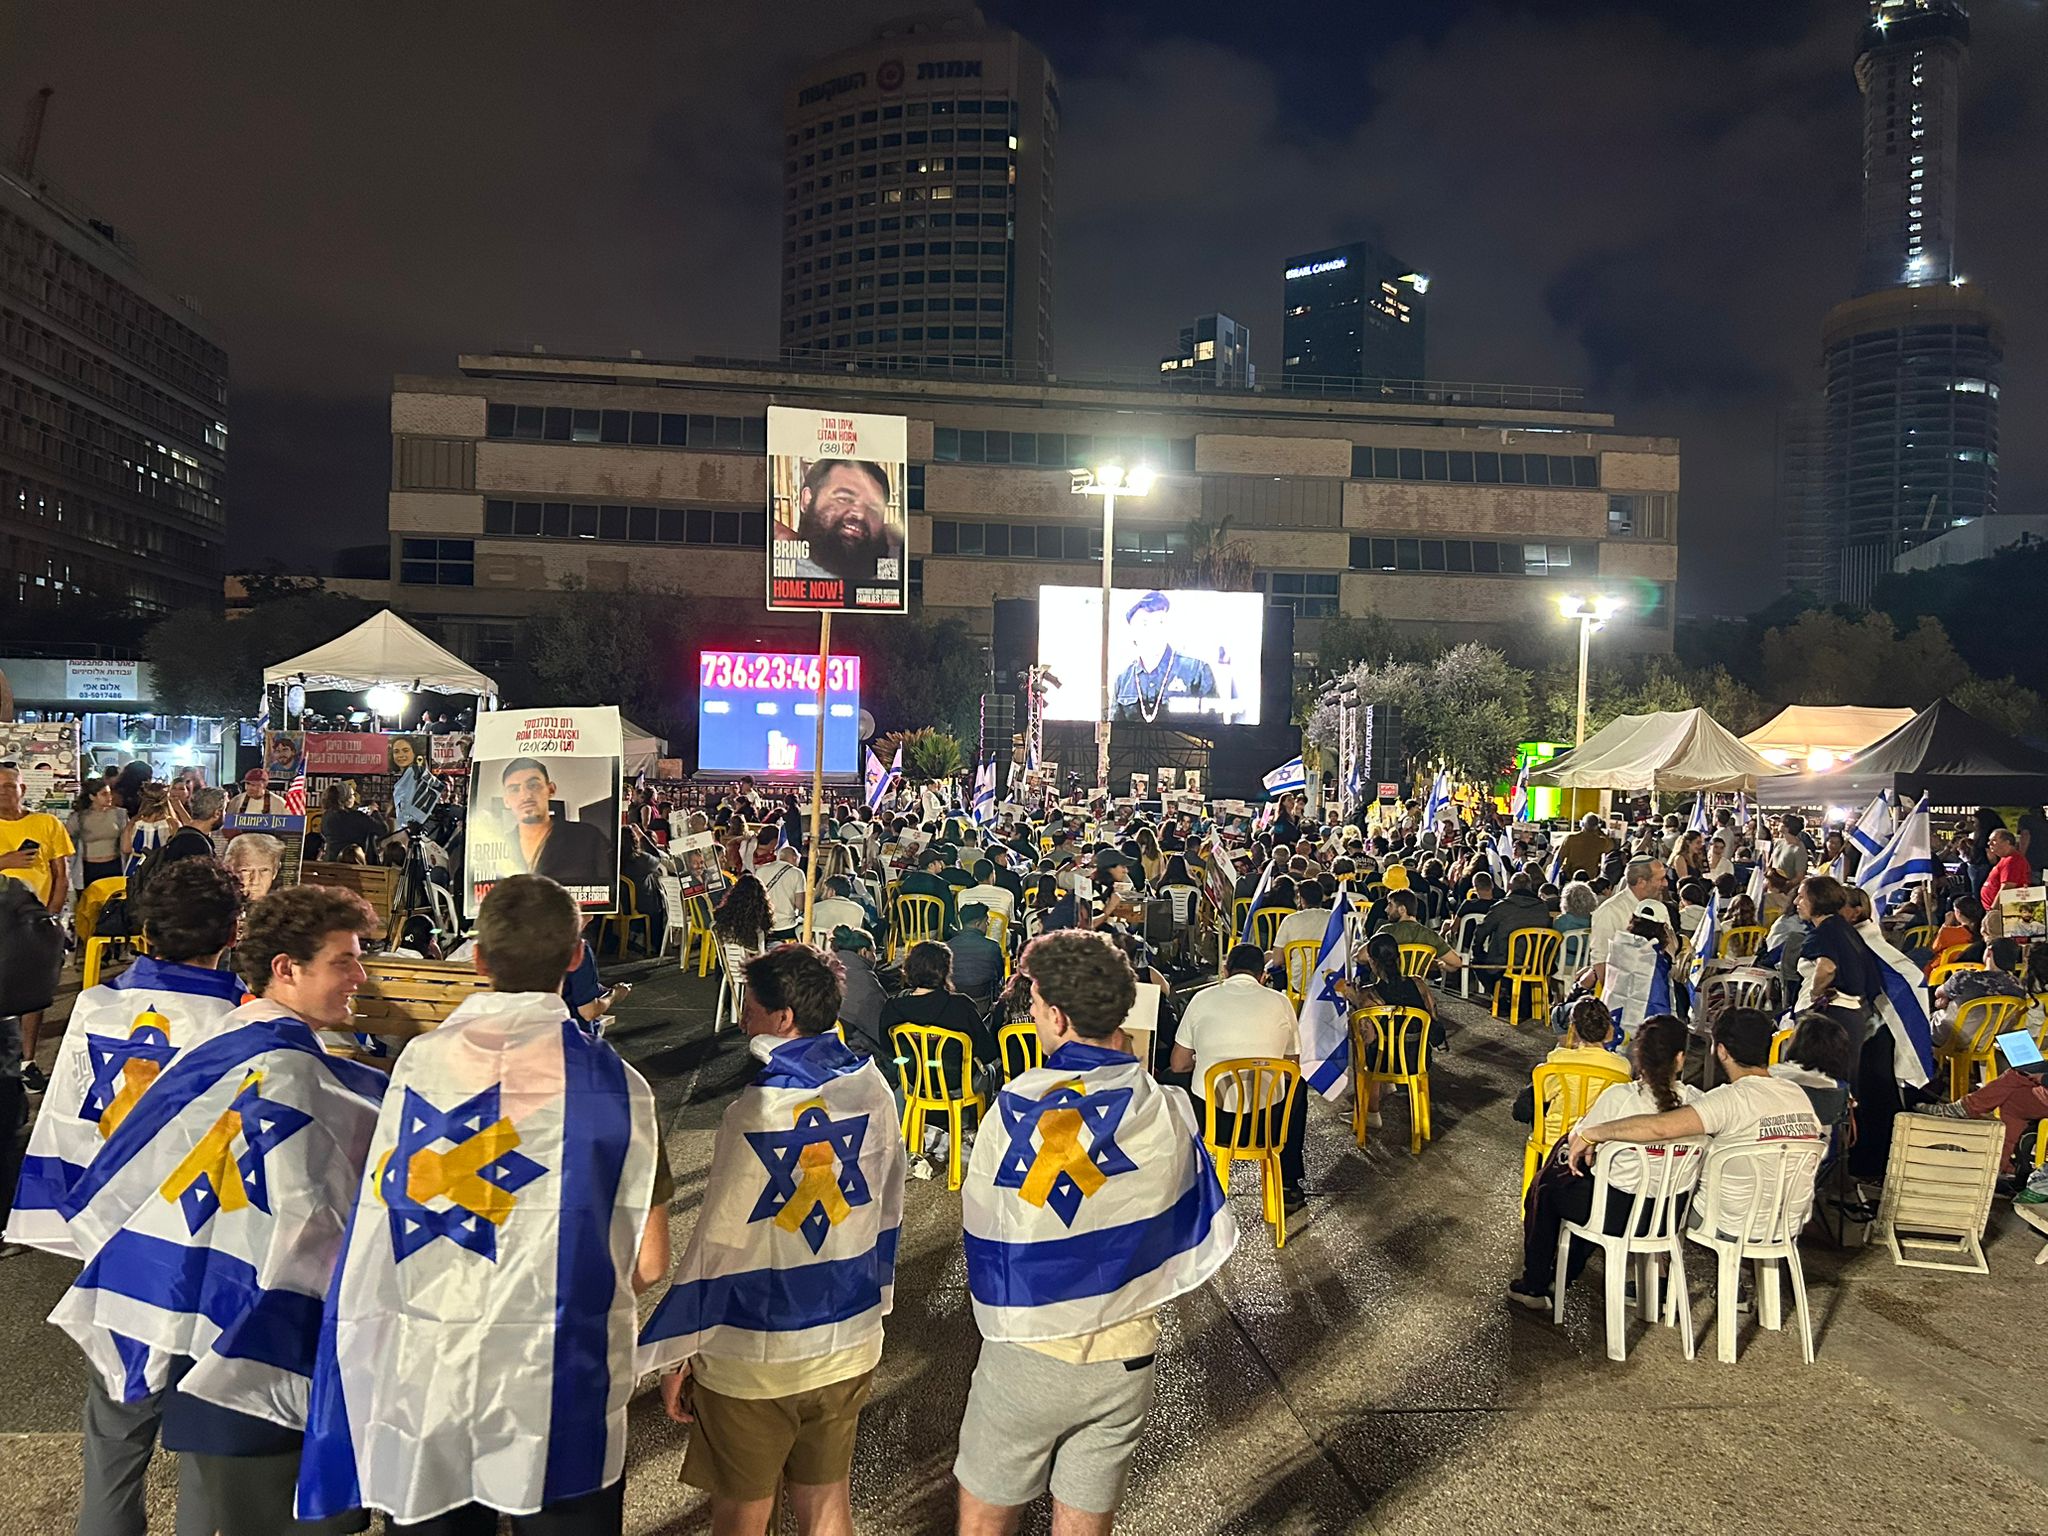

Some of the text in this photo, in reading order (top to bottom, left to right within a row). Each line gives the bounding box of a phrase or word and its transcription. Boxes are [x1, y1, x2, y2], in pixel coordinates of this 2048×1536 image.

[1312, 257, 1347, 274] CANADA
[818, 429, 857, 442] EITAN HORN
[819, 443, 840, 455] (38)
[773, 540, 810, 559] BRING
[773, 559, 796, 578] HIM
[773, 579, 844, 600] HOME NOW!
[701, 654, 855, 691] 736:23:4631
[560, 718, 573, 728] רום
[516, 729, 580, 741] ROM BRASLAVSKI
[234, 815, 288, 828] TRUMP'S LIST
[1760, 1124, 1797, 1138] FAMILIES
